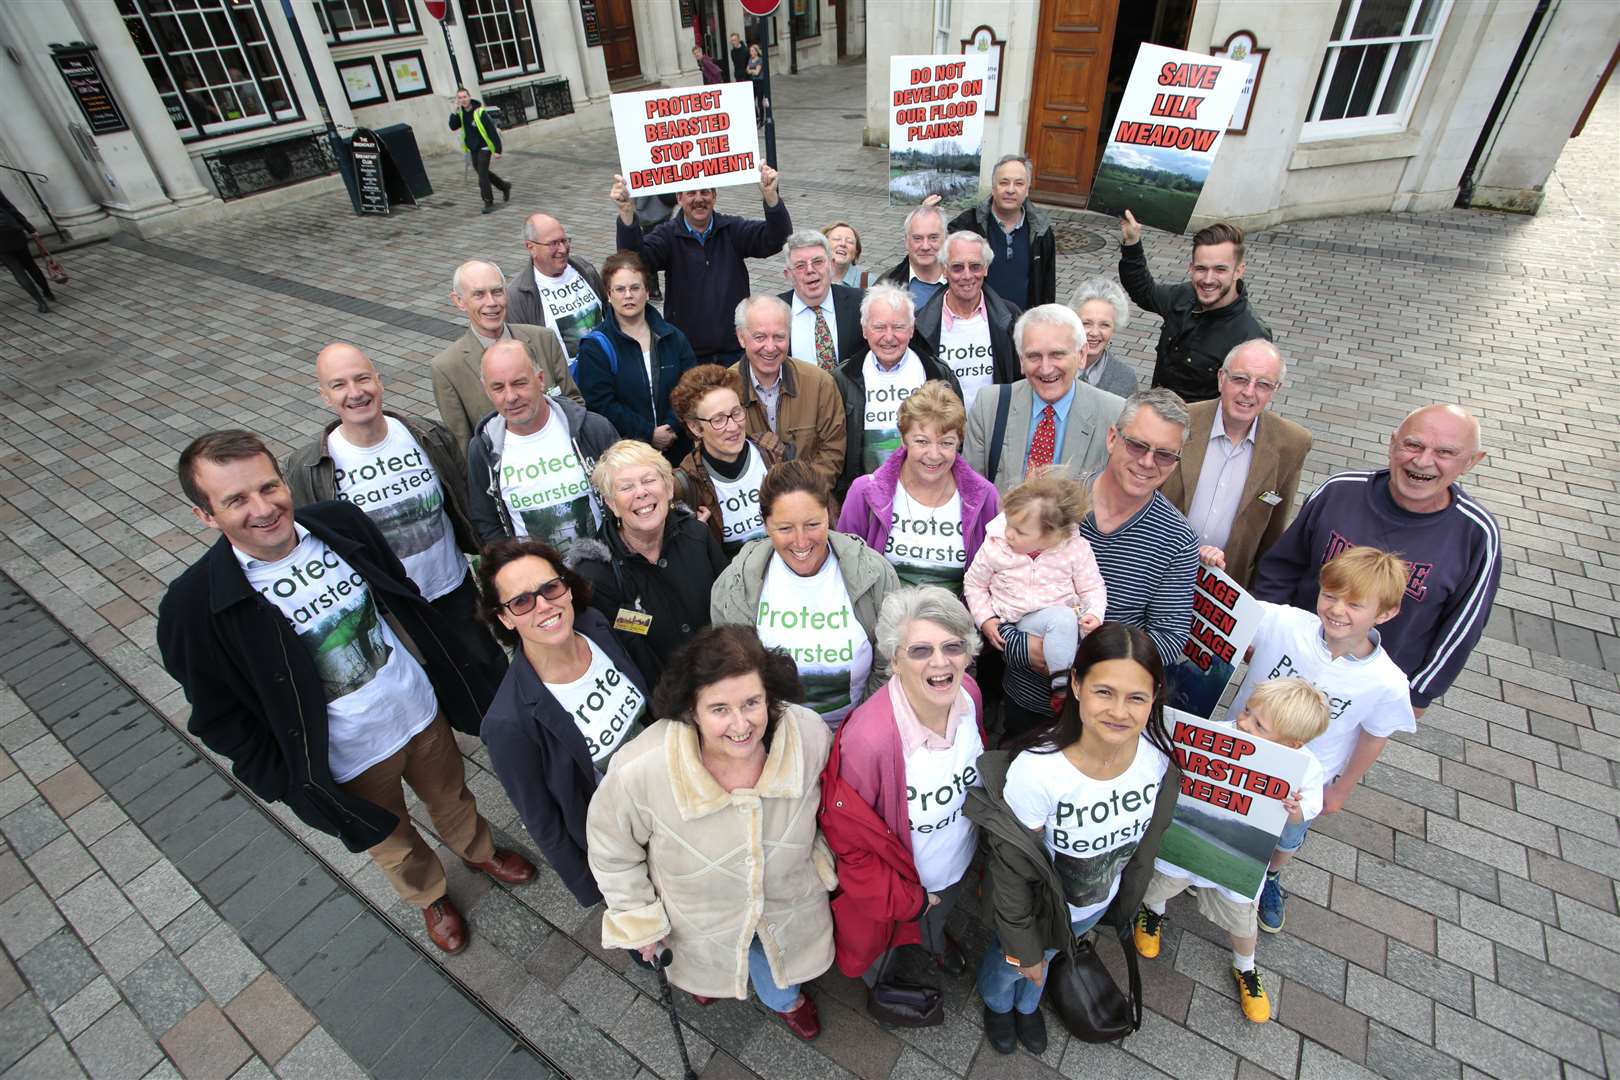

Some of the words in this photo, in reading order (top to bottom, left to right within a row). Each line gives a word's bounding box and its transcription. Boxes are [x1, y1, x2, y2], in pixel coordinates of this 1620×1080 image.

[911, 67, 931, 85] DO
[935, 62, 966, 82] NOT
[1158, 62, 1221, 89] SAVE
[645, 90, 722, 119] PROTECT
[894, 83, 958, 106] DEVELOP
[961, 79, 983, 97] ON
[1150, 93, 1205, 120] LILK
[645, 112, 730, 143] BEARSTED
[896, 107, 927, 125] OUR
[930, 101, 978, 121] FLOOD
[908, 121, 964, 141] PLAINS!
[1115, 121, 1220, 152] MEADOW
[651, 140, 694, 164] STOP
[696, 135, 730, 156] THE
[630, 152, 754, 189] DEVELOPMENT!
[549, 289, 595, 316] Bearsted
[938, 344, 993, 360] Protec
[955, 364, 993, 377] arste
[867, 384, 920, 402] rote
[335, 447, 424, 490] Protect
[510, 473, 589, 509] Bearsted
[892, 512, 963, 537] Protec
[885, 537, 967, 562] Bearste
[1195, 564, 1241, 611] LAGE
[758, 602, 849, 630] Protect
[1192, 589, 1237, 637] DREN
[575, 667, 621, 725] rote
[584, 685, 641, 757] Bearst
[1173, 720, 1256, 761] KEEP
[906, 766, 977, 811] Prote
[1172, 747, 1291, 801] ARSTED
[1056, 783, 1159, 827] Protec
[1179, 774, 1253, 817] REEN
[1053, 817, 1152, 853] Bearste
